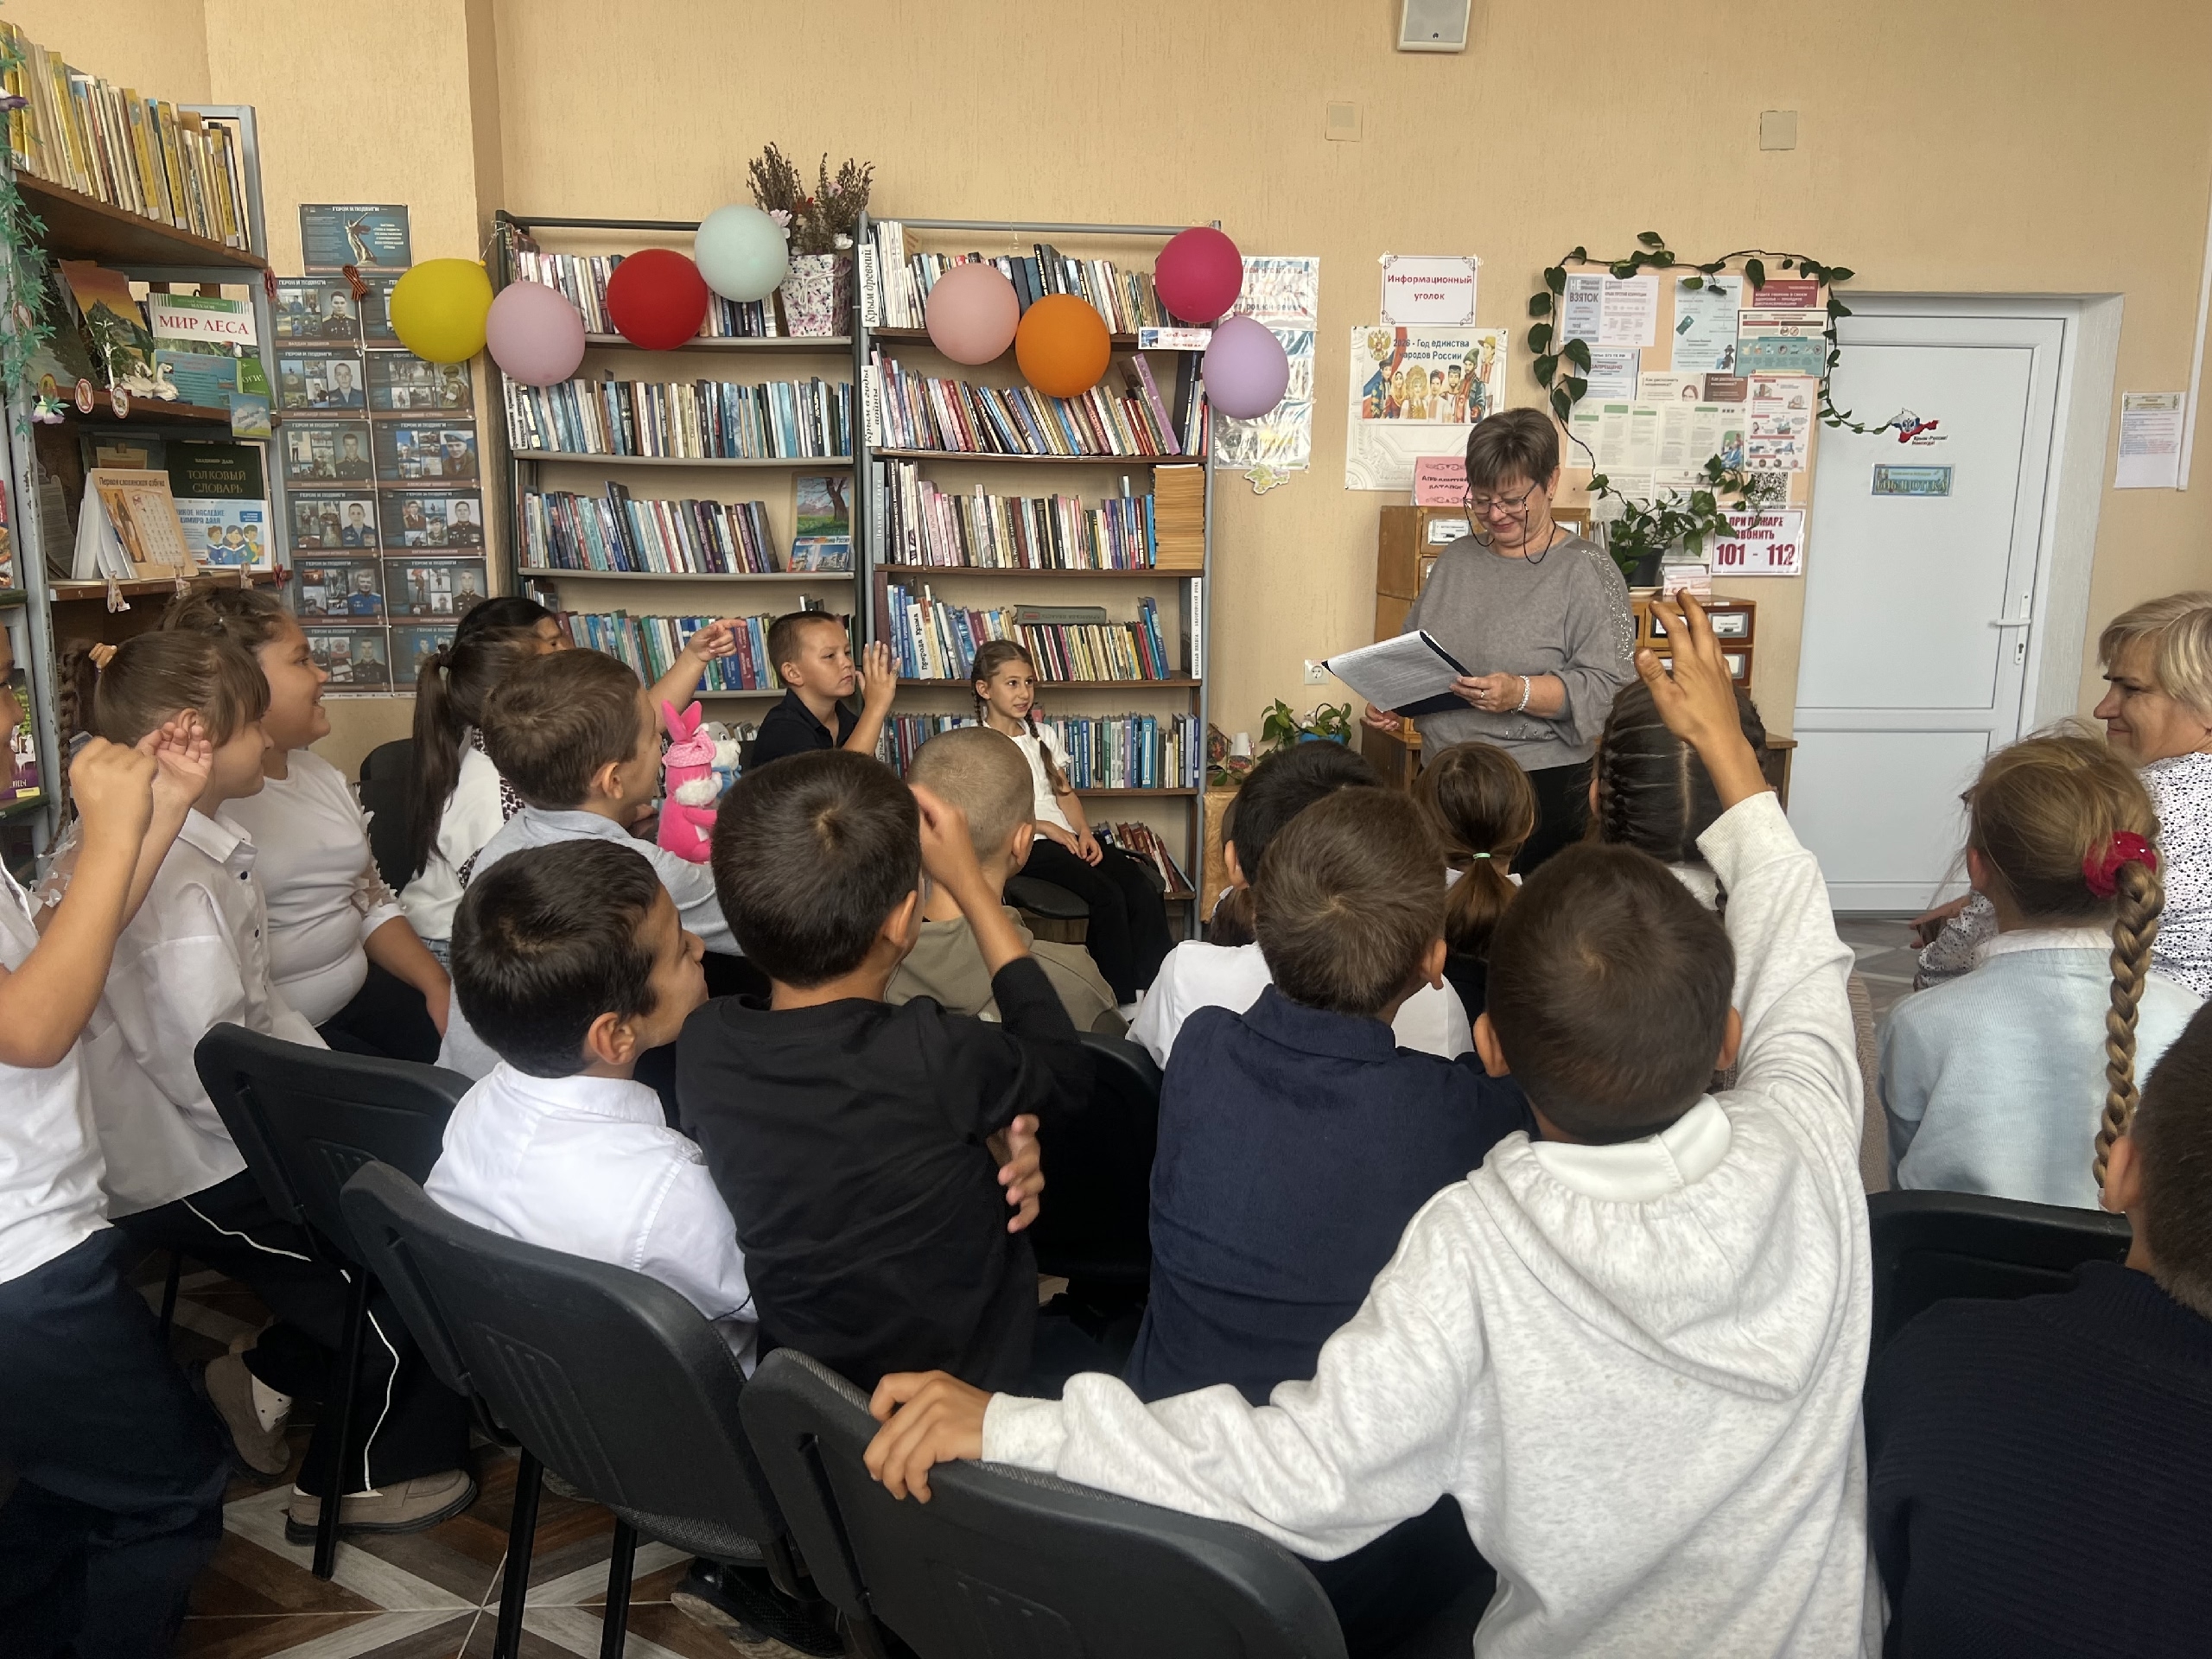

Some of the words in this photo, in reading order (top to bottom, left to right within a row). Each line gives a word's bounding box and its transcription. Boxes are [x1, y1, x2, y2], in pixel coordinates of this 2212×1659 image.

[861, 250, 875, 290] древний
[1388, 274, 1472, 284] Информационный
[1570, 280, 1581, 290] НЕ
[1414, 292, 1445, 301] уголок
[1570, 292, 1599, 302] ВЗЯТОК
[865, 293, 877, 323] Крым
[159, 315, 199, 330] МИР
[203, 319, 249, 335] ЛЕСА
[1417, 339, 1430, 348] Год
[1431, 340, 1469, 348] единства
[1433, 352, 1462, 360] России
[187, 470, 246, 481] ТОЛКОВЫЙ
[99, 477, 118, 486] Первая
[149, 479, 165, 488] азбука
[192, 483, 243, 494] СЛОВАРЬ
[1729, 517, 1746, 526] ПРИ
[1748, 517, 1784, 527] ПЖАРЕ
[1735, 530, 1775, 540] ЗВОНИТЬ
[1717, 543, 1746, 565] 101
[1767, 544, 1795, 566] 112
[914, 613, 922, 636] Крыма
[918, 639, 927, 670] Природа
